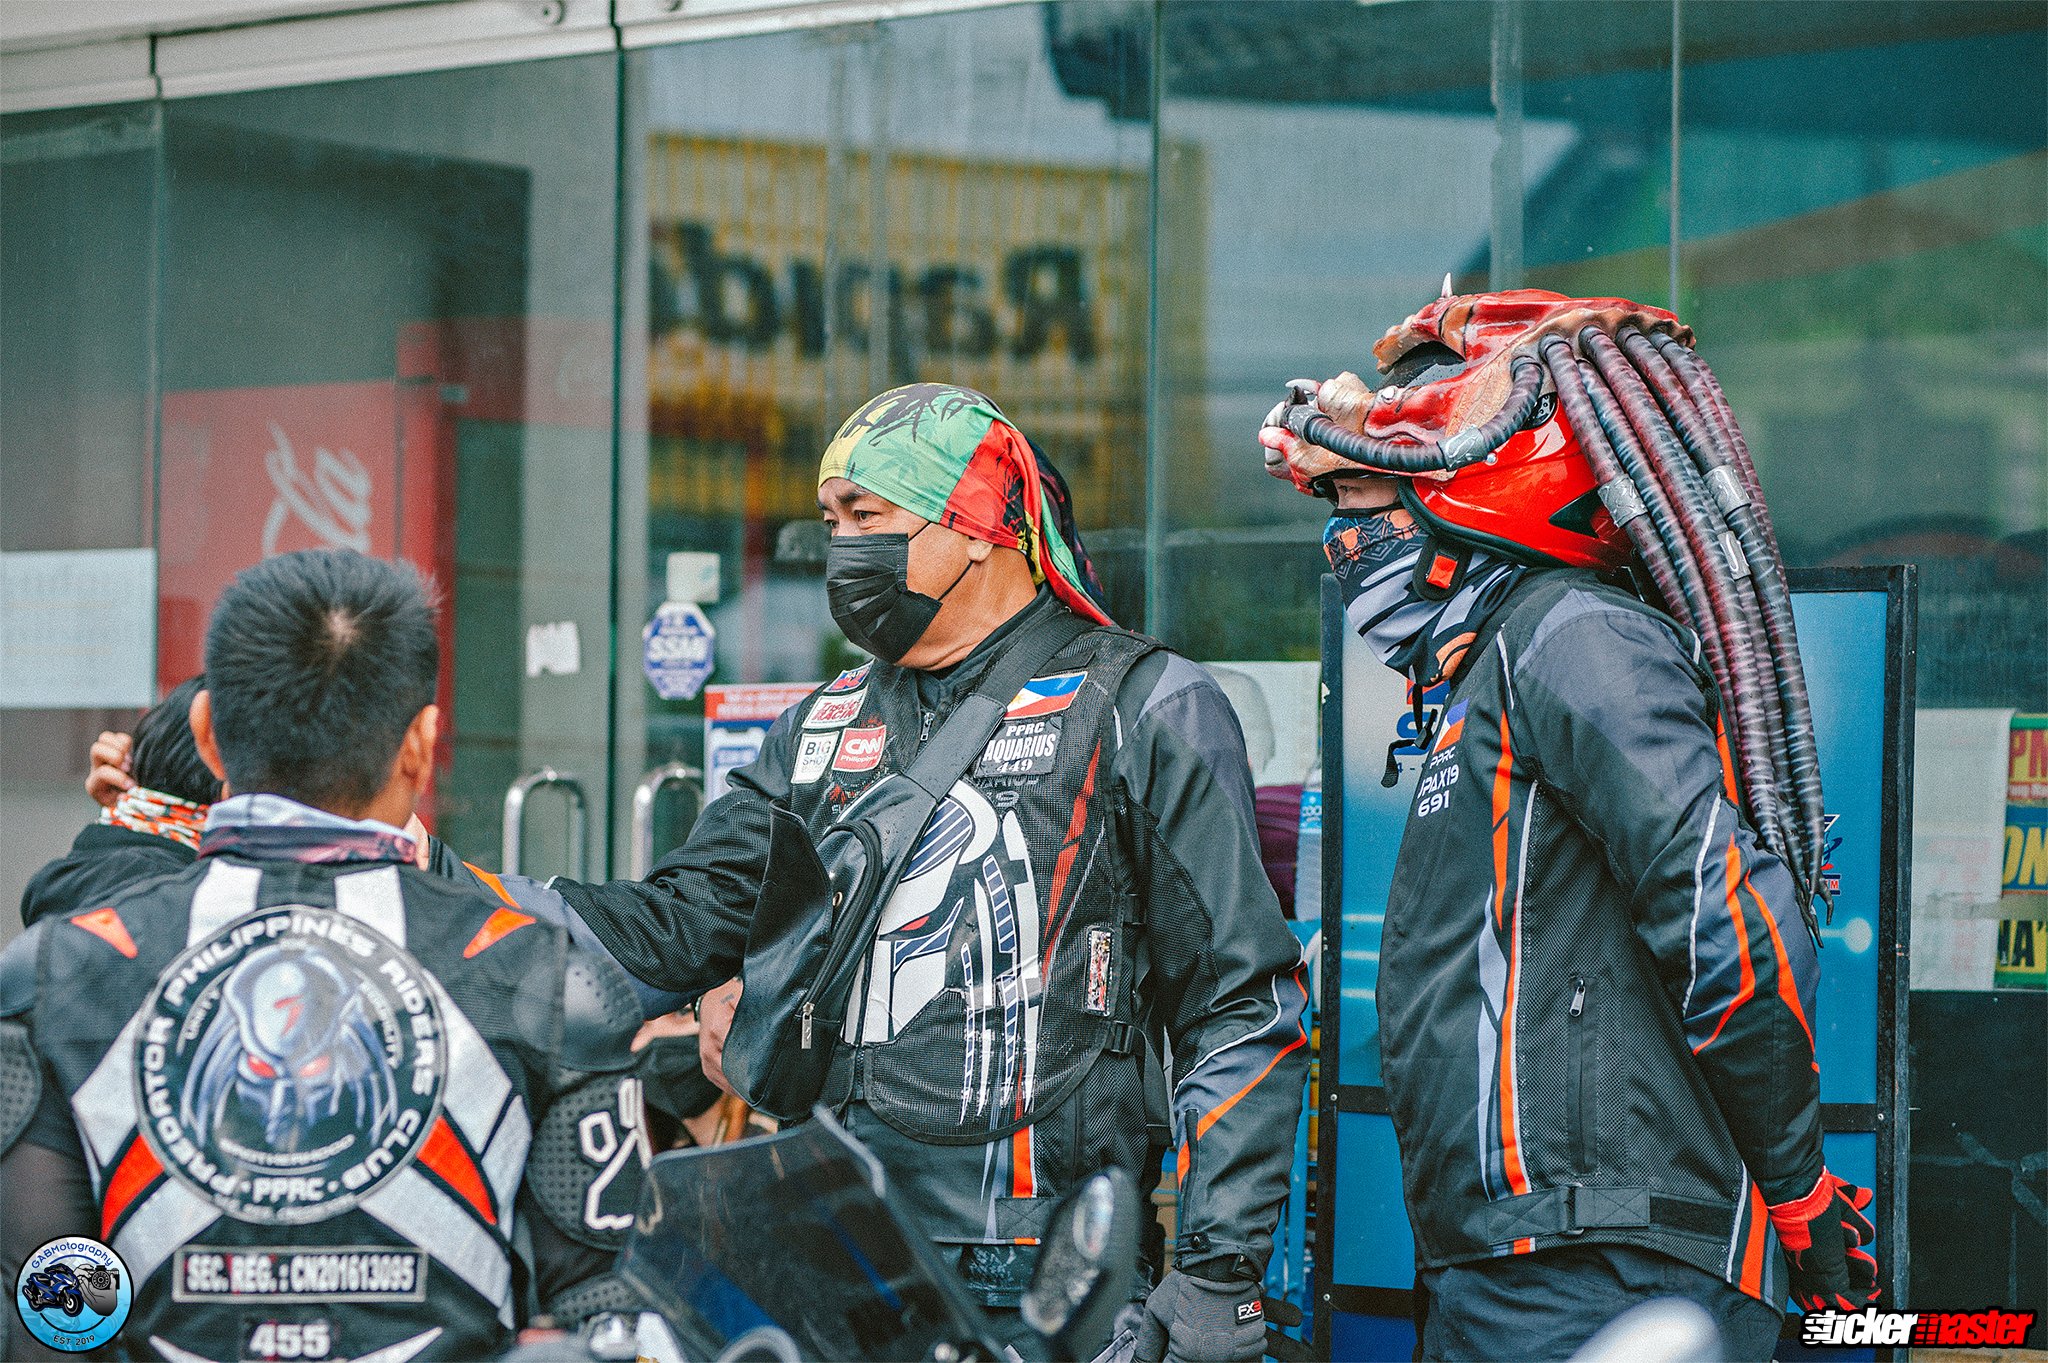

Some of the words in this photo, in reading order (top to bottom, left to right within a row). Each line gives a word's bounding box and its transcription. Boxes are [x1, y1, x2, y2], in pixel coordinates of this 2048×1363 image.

[1006, 722, 1045, 737] PPRC
[804, 741, 831, 756] BIG
[845, 735, 883, 754] CNN
[983, 734, 1057, 763] AQUARIUS
[997, 759, 1033, 773] 449
[1429, 746, 1456, 769] PPRC
[1417, 790, 1451, 818] 691
[250, 1323, 330, 1358] 455
